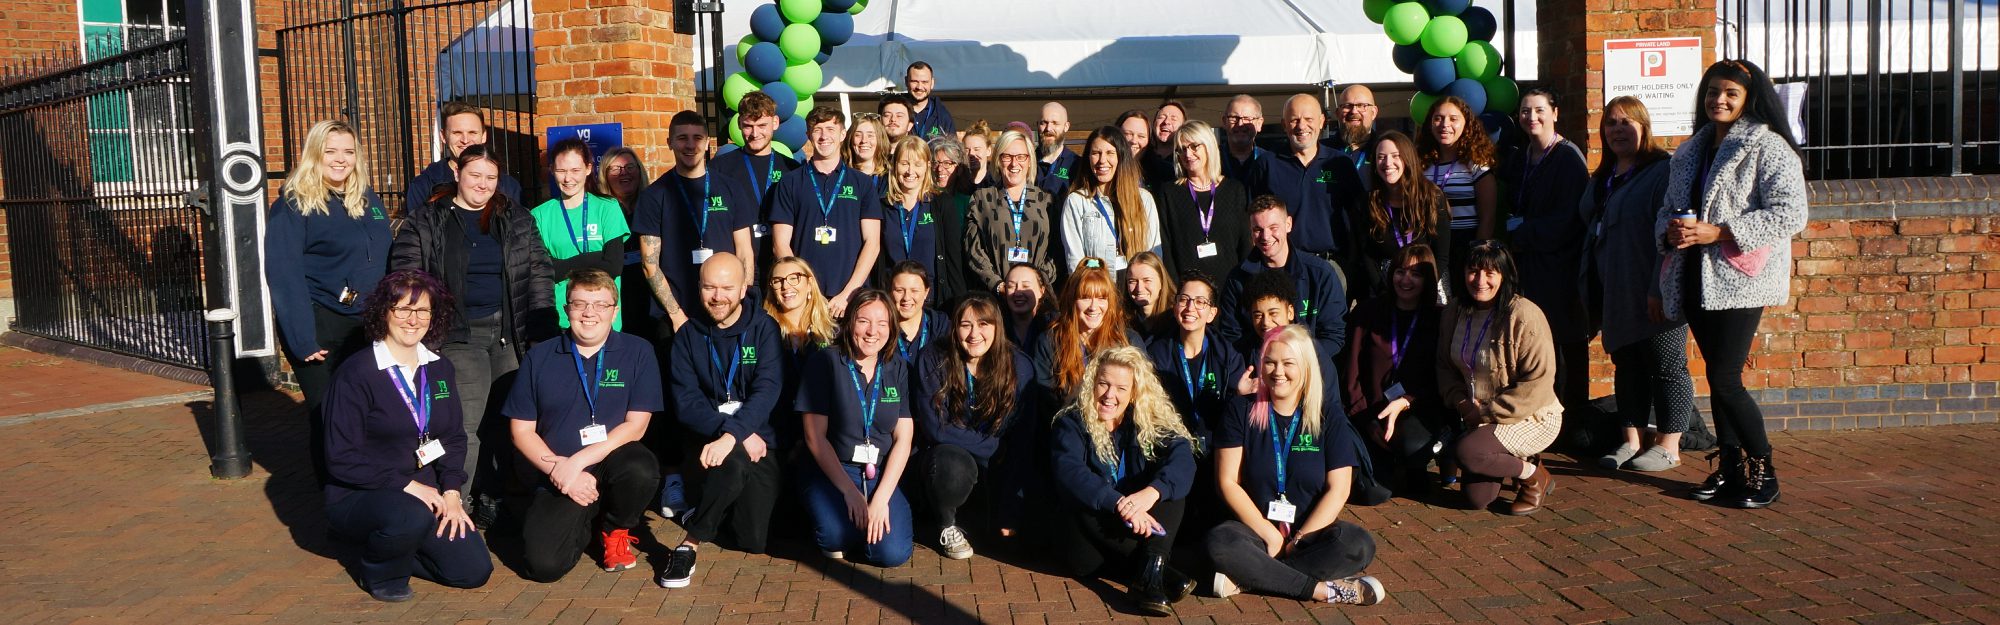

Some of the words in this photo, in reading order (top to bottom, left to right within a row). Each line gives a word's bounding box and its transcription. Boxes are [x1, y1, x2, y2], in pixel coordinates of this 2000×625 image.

[1643, 52, 1663, 77] P
[1641, 83, 1674, 91] HOLDERS
[772, 171, 781, 179] yg
[843, 186, 853, 194] yg
[711, 196, 722, 206] yg
[742, 347, 755, 358] yg
[604, 369, 618, 381] yg
[884, 387, 898, 398] yg
[1299, 434, 1311, 446] yg
